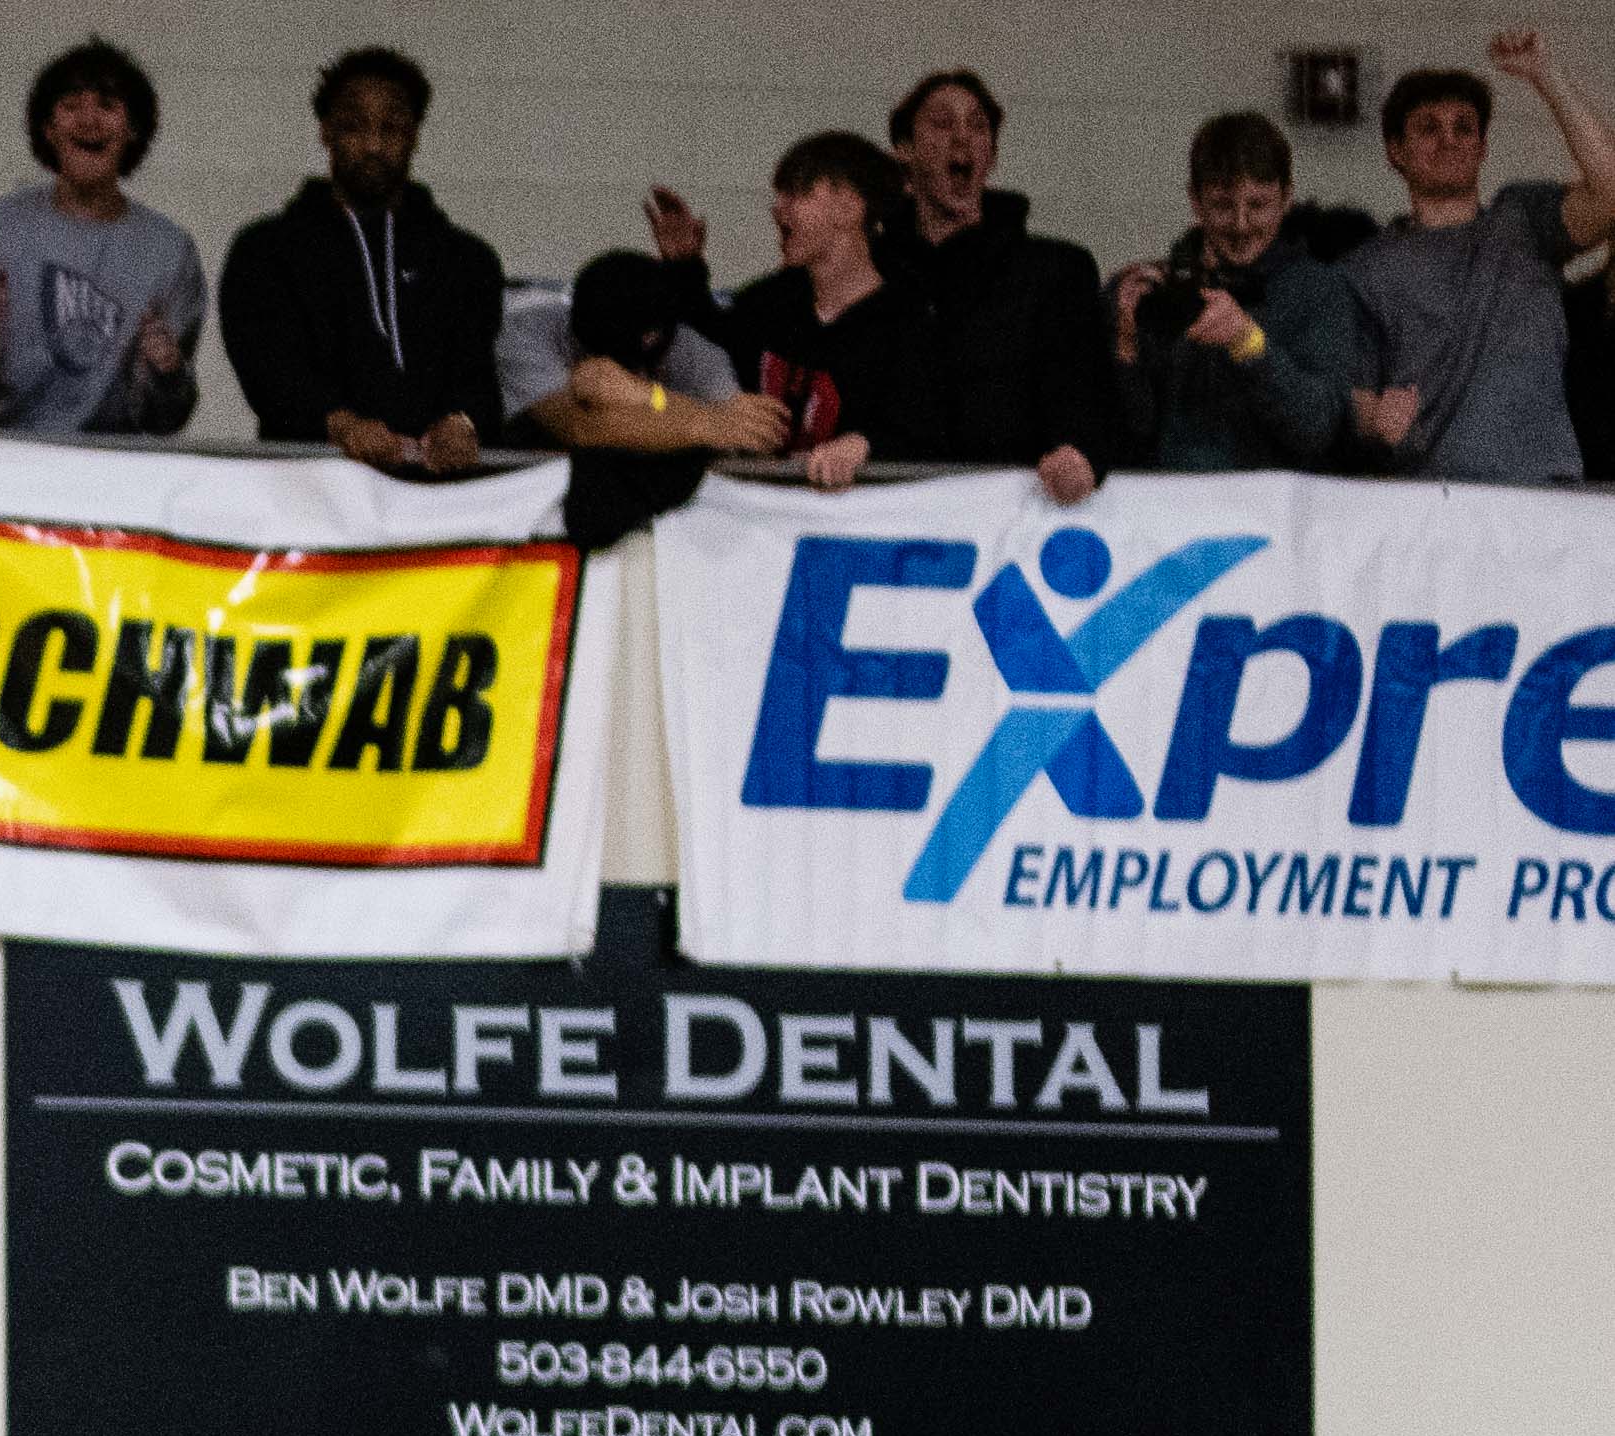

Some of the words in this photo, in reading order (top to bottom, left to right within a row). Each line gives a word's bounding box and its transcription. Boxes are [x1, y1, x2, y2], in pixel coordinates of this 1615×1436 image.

[1003, 844, 1477, 920] EMPLOYMENT
[114, 980, 618, 1097] WOLFE
[664, 993, 1210, 1115] DENTAL
[106, 1141, 402, 1203] COSMETIC,
[419, 1149, 601, 1204] FAMILY
[612, 1155, 658, 1204] &
[672, 1155, 902, 1212] IMPLANT
[916, 1161, 1209, 1219] DENTISTRY
[228, 1266, 320, 1310] BEN
[329, 1269, 486, 1316] WOLFE
[498, 1272, 609, 1318] DMD
[620, 1275, 656, 1319] &
[665, 1277, 779, 1322] JOSH
[791, 1279, 970, 1327] ROWLEY
[984, 1285, 1092, 1330] DMD
[497, 1340, 828, 1389] 503-844-6550
